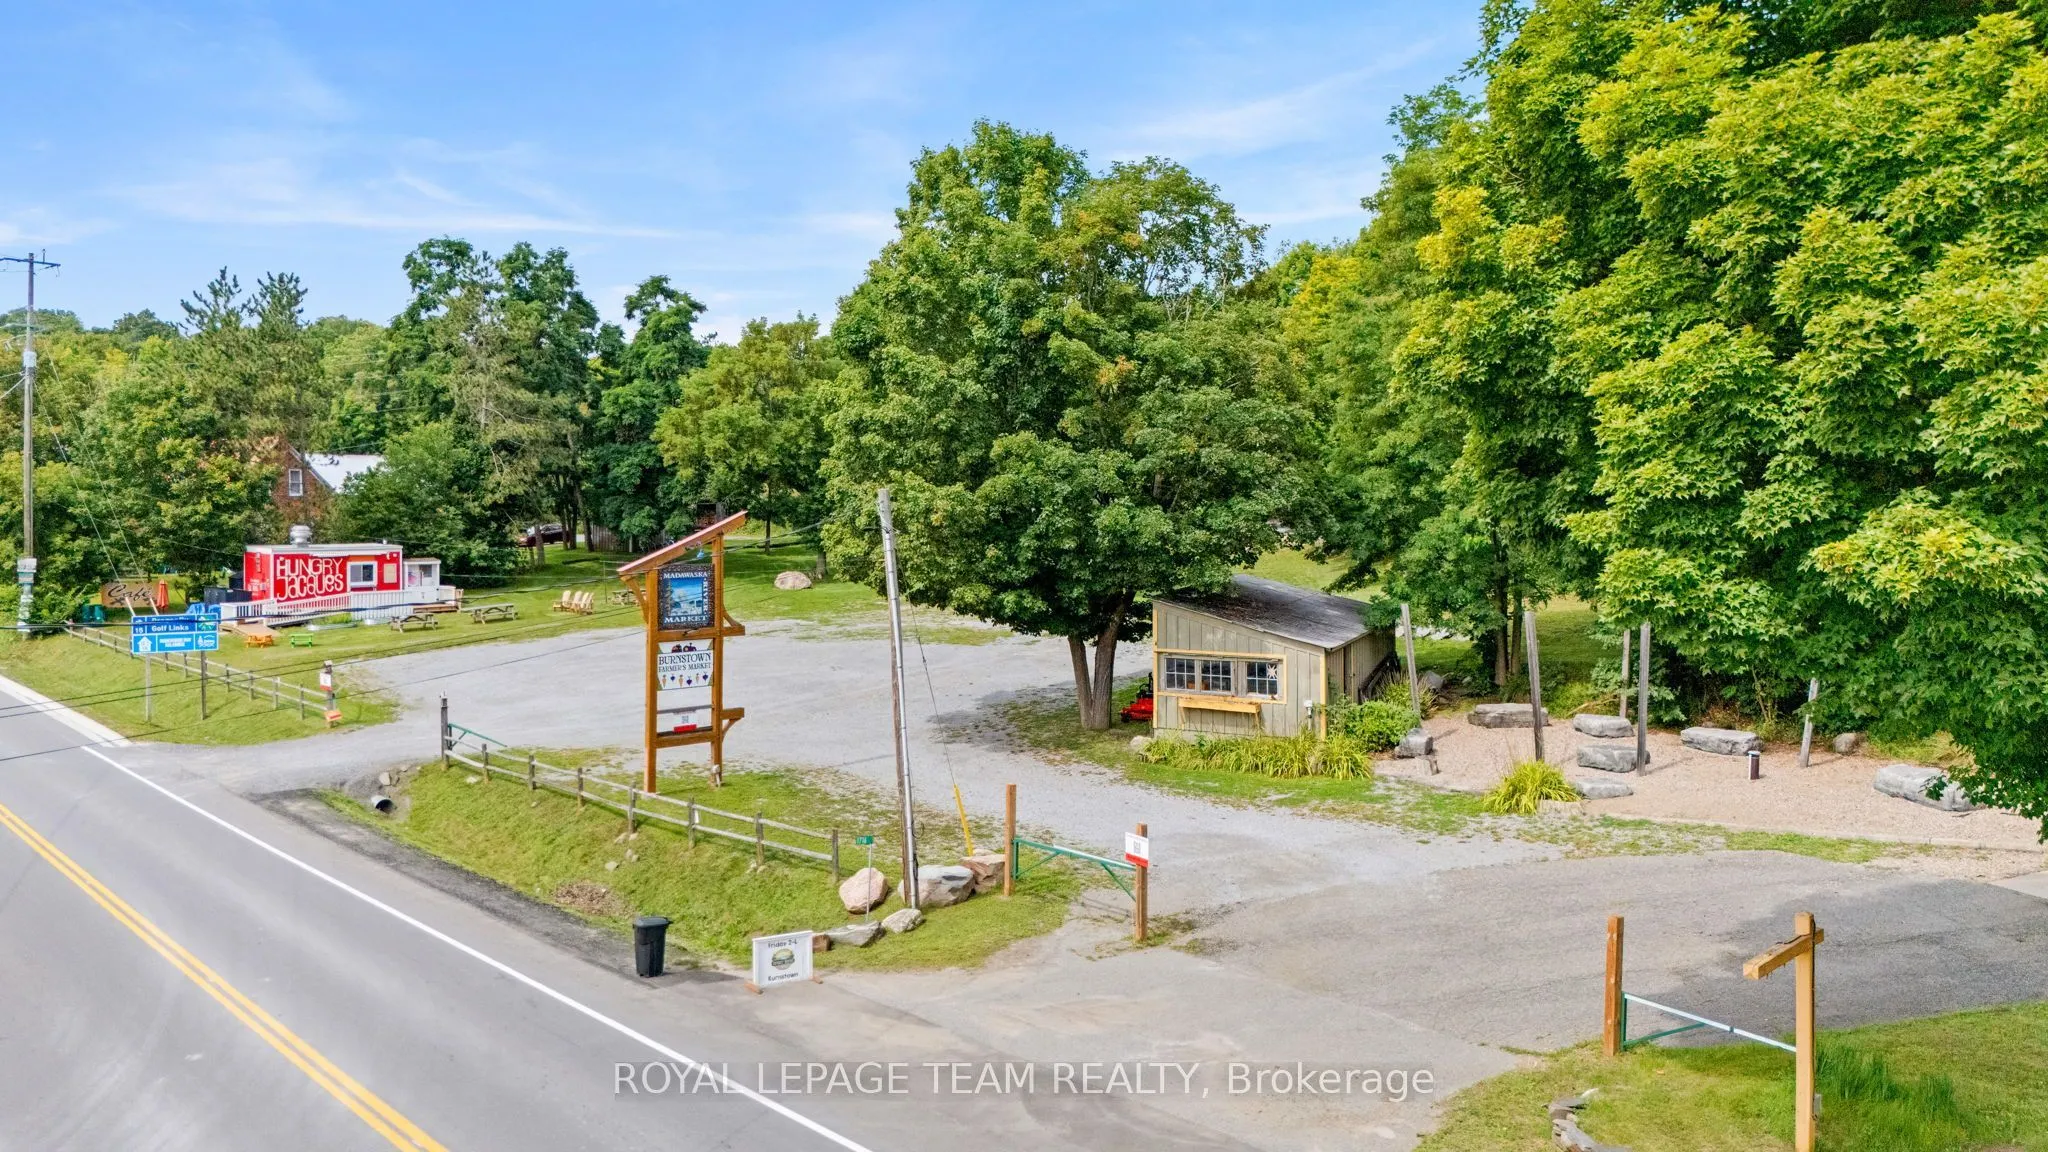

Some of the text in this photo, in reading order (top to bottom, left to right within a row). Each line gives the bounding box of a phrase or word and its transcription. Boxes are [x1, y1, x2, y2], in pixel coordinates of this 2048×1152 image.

[276, 557, 343, 577] HUNGRY
[663, 571, 708, 579] MADAWASKA
[664, 615, 707, 623] MARKET
[151, 624, 168, 632] Golf
[658, 652, 711, 665] BURNSTOWN
